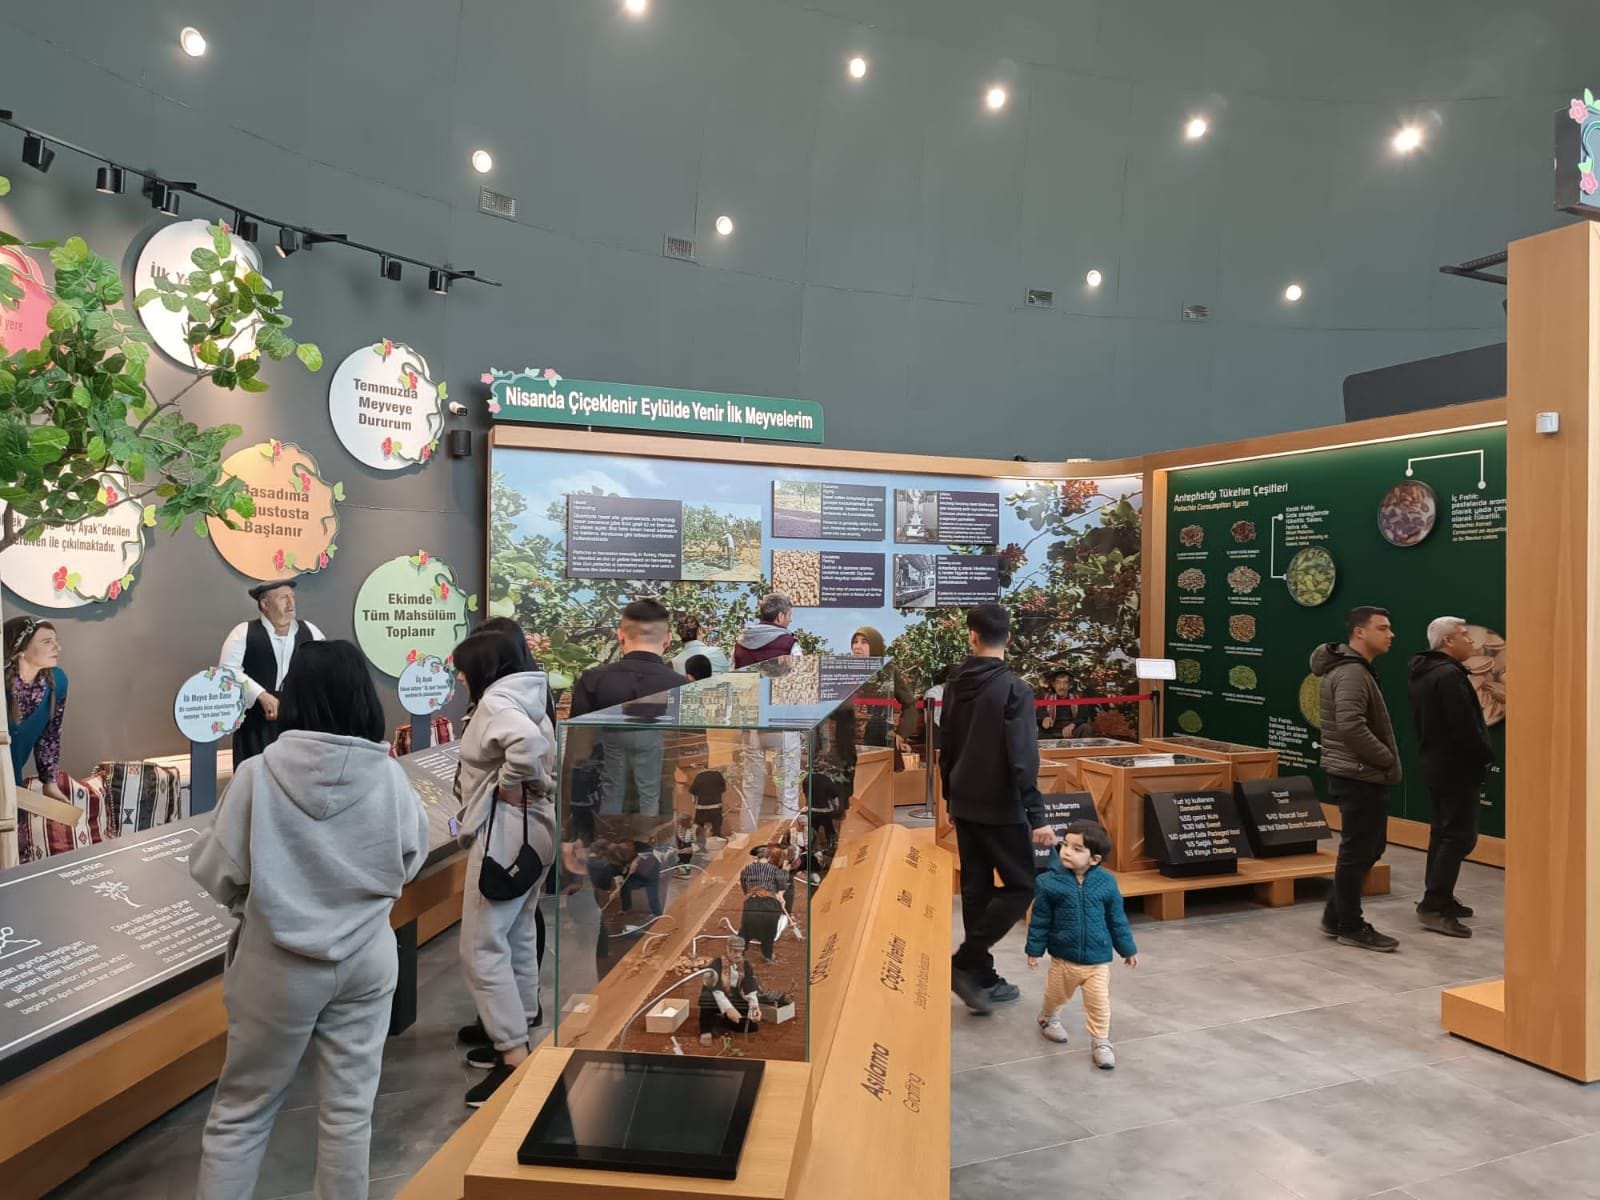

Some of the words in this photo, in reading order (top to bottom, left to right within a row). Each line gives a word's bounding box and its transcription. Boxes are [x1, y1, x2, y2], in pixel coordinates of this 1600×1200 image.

[353, 378, 418, 399] Temmuzda
[359, 396, 412, 416] Meyveye
[506, 386, 565, 409] Nisanda
[568, 391, 637, 416] Çiçeklenir
[640, 397, 690, 421] Eylülde
[692, 401, 724, 422] Yenir
[727, 400, 742, 424] İlk
[746, 406, 813, 430] Meyvelerim
[358, 413, 412, 431] Dururum
[1219, 487, 1251, 499] Tüketim
[1253, 482, 1289, 497] Çeşitleri
[252, 503, 309, 520] ustosta
[244, 521, 303, 538] Başlanır
[49, 536, 59, 548] ile
[62, 538, 116, 552] çıkılmaktadır.
[388, 593, 433, 605] Ekimde
[362, 609, 390, 622] Tüm
[394, 609, 456, 621] Mahsülüm
[386, 626, 436, 640] Toplanır
[4, 995, 25, 1009] With
[23, 991, 38, 1001] the
[38, 974, 82, 996] germination
[20, 999, 49, 1016] begins
[860, 1041, 892, 1102] Aşılama
